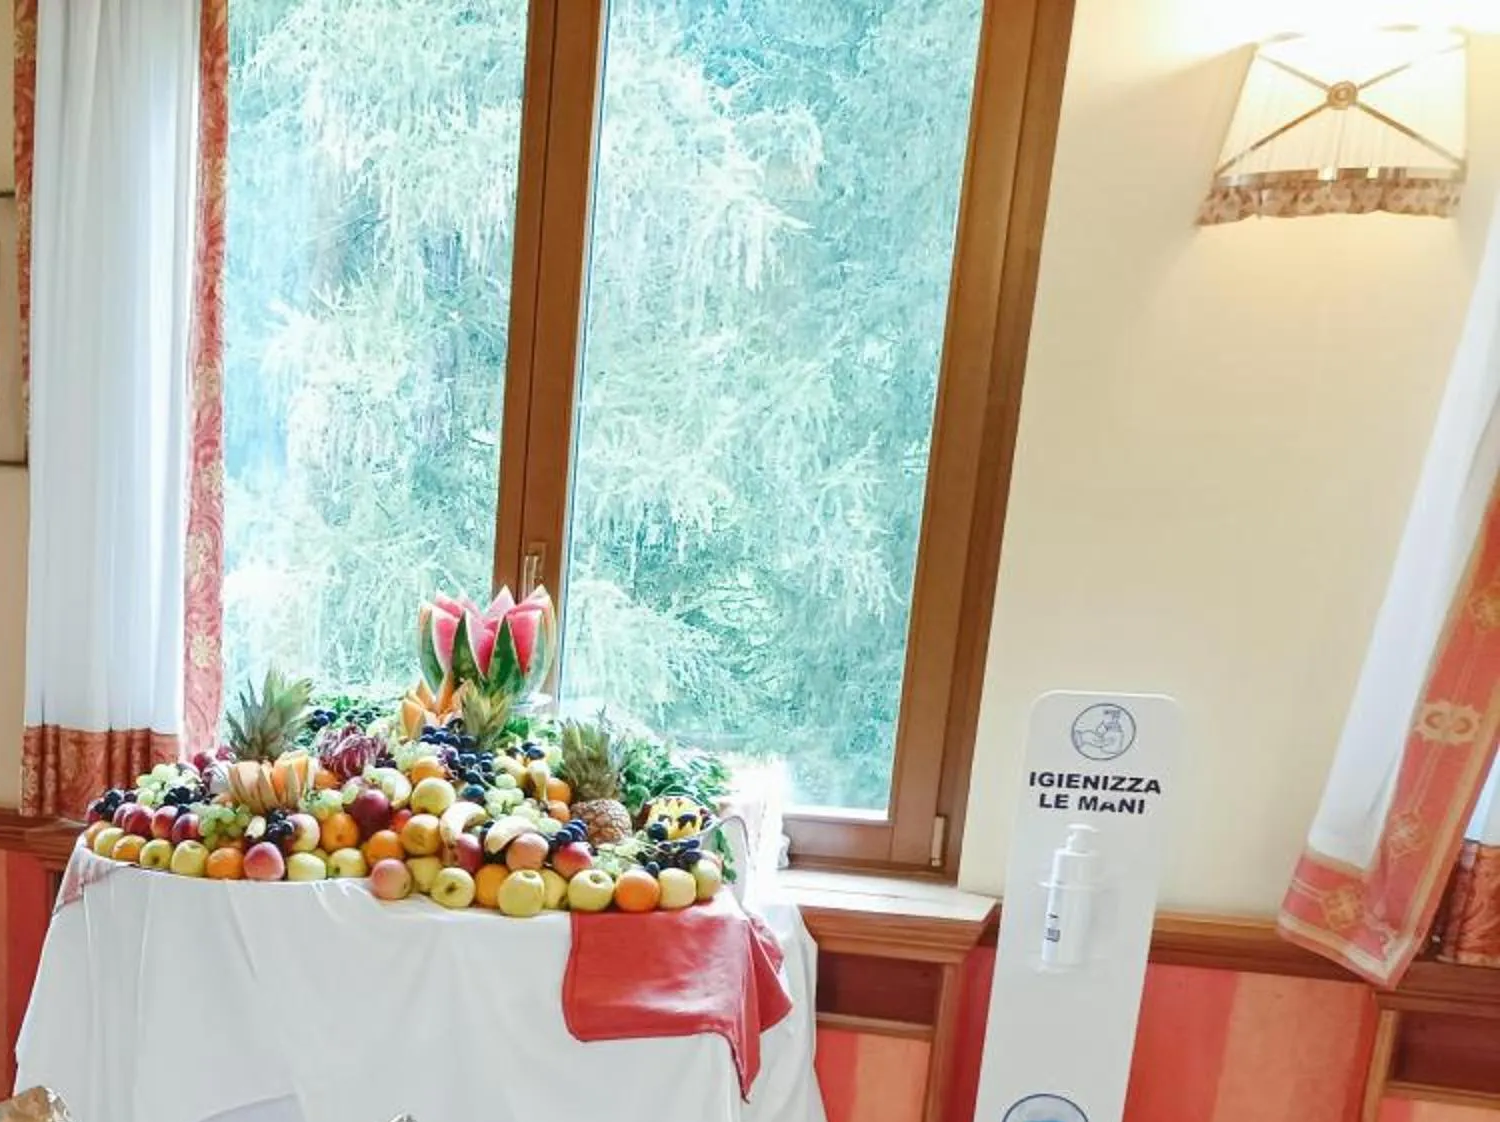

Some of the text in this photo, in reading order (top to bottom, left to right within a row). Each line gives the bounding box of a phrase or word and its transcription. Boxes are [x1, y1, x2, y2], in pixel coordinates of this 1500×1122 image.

[1029, 771, 1161, 794] IGIENIZZA
[1039, 793, 1145, 815] LE MANI
